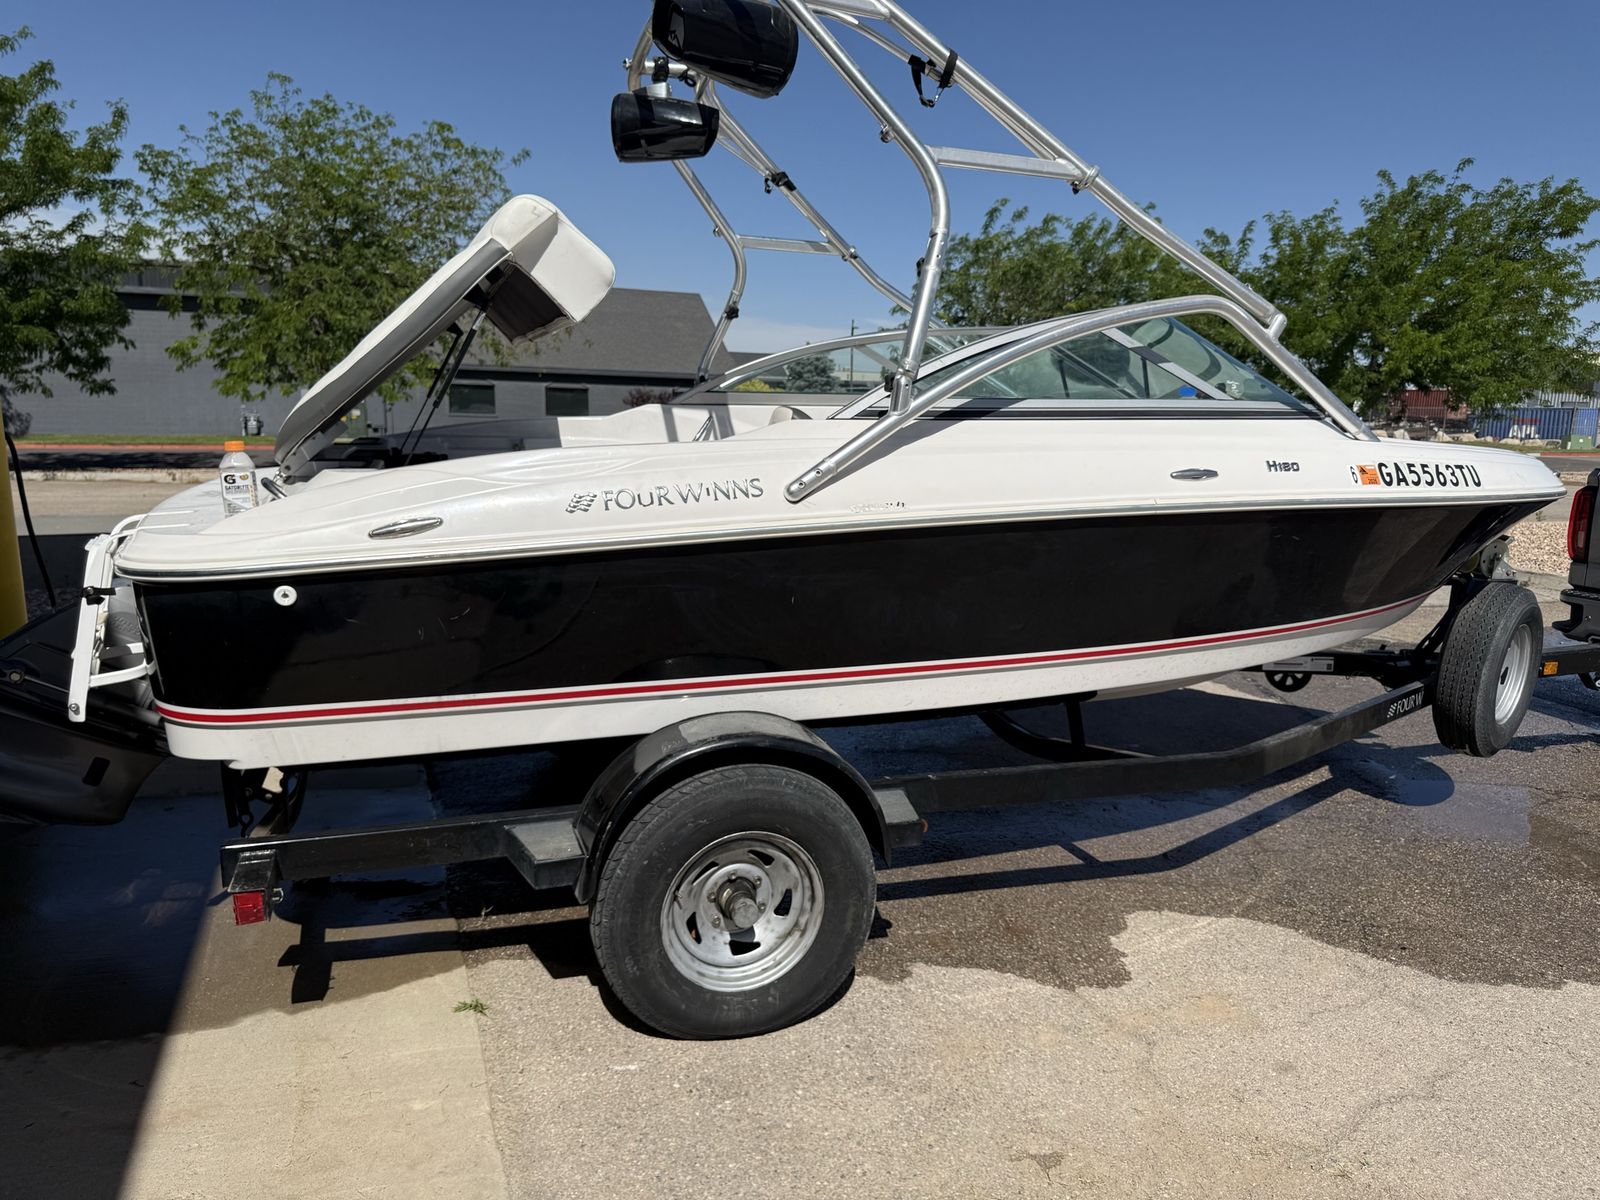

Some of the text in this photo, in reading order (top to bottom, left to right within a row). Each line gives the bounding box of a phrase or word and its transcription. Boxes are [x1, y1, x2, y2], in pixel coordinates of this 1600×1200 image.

[224, 474, 236, 485] G
[1350, 465, 1358, 484] 6
[1377, 462, 1482, 487] GA5563TU
[601, 488, 675, 512] FOUR
[1396, 694, 1415, 715] FOUR
